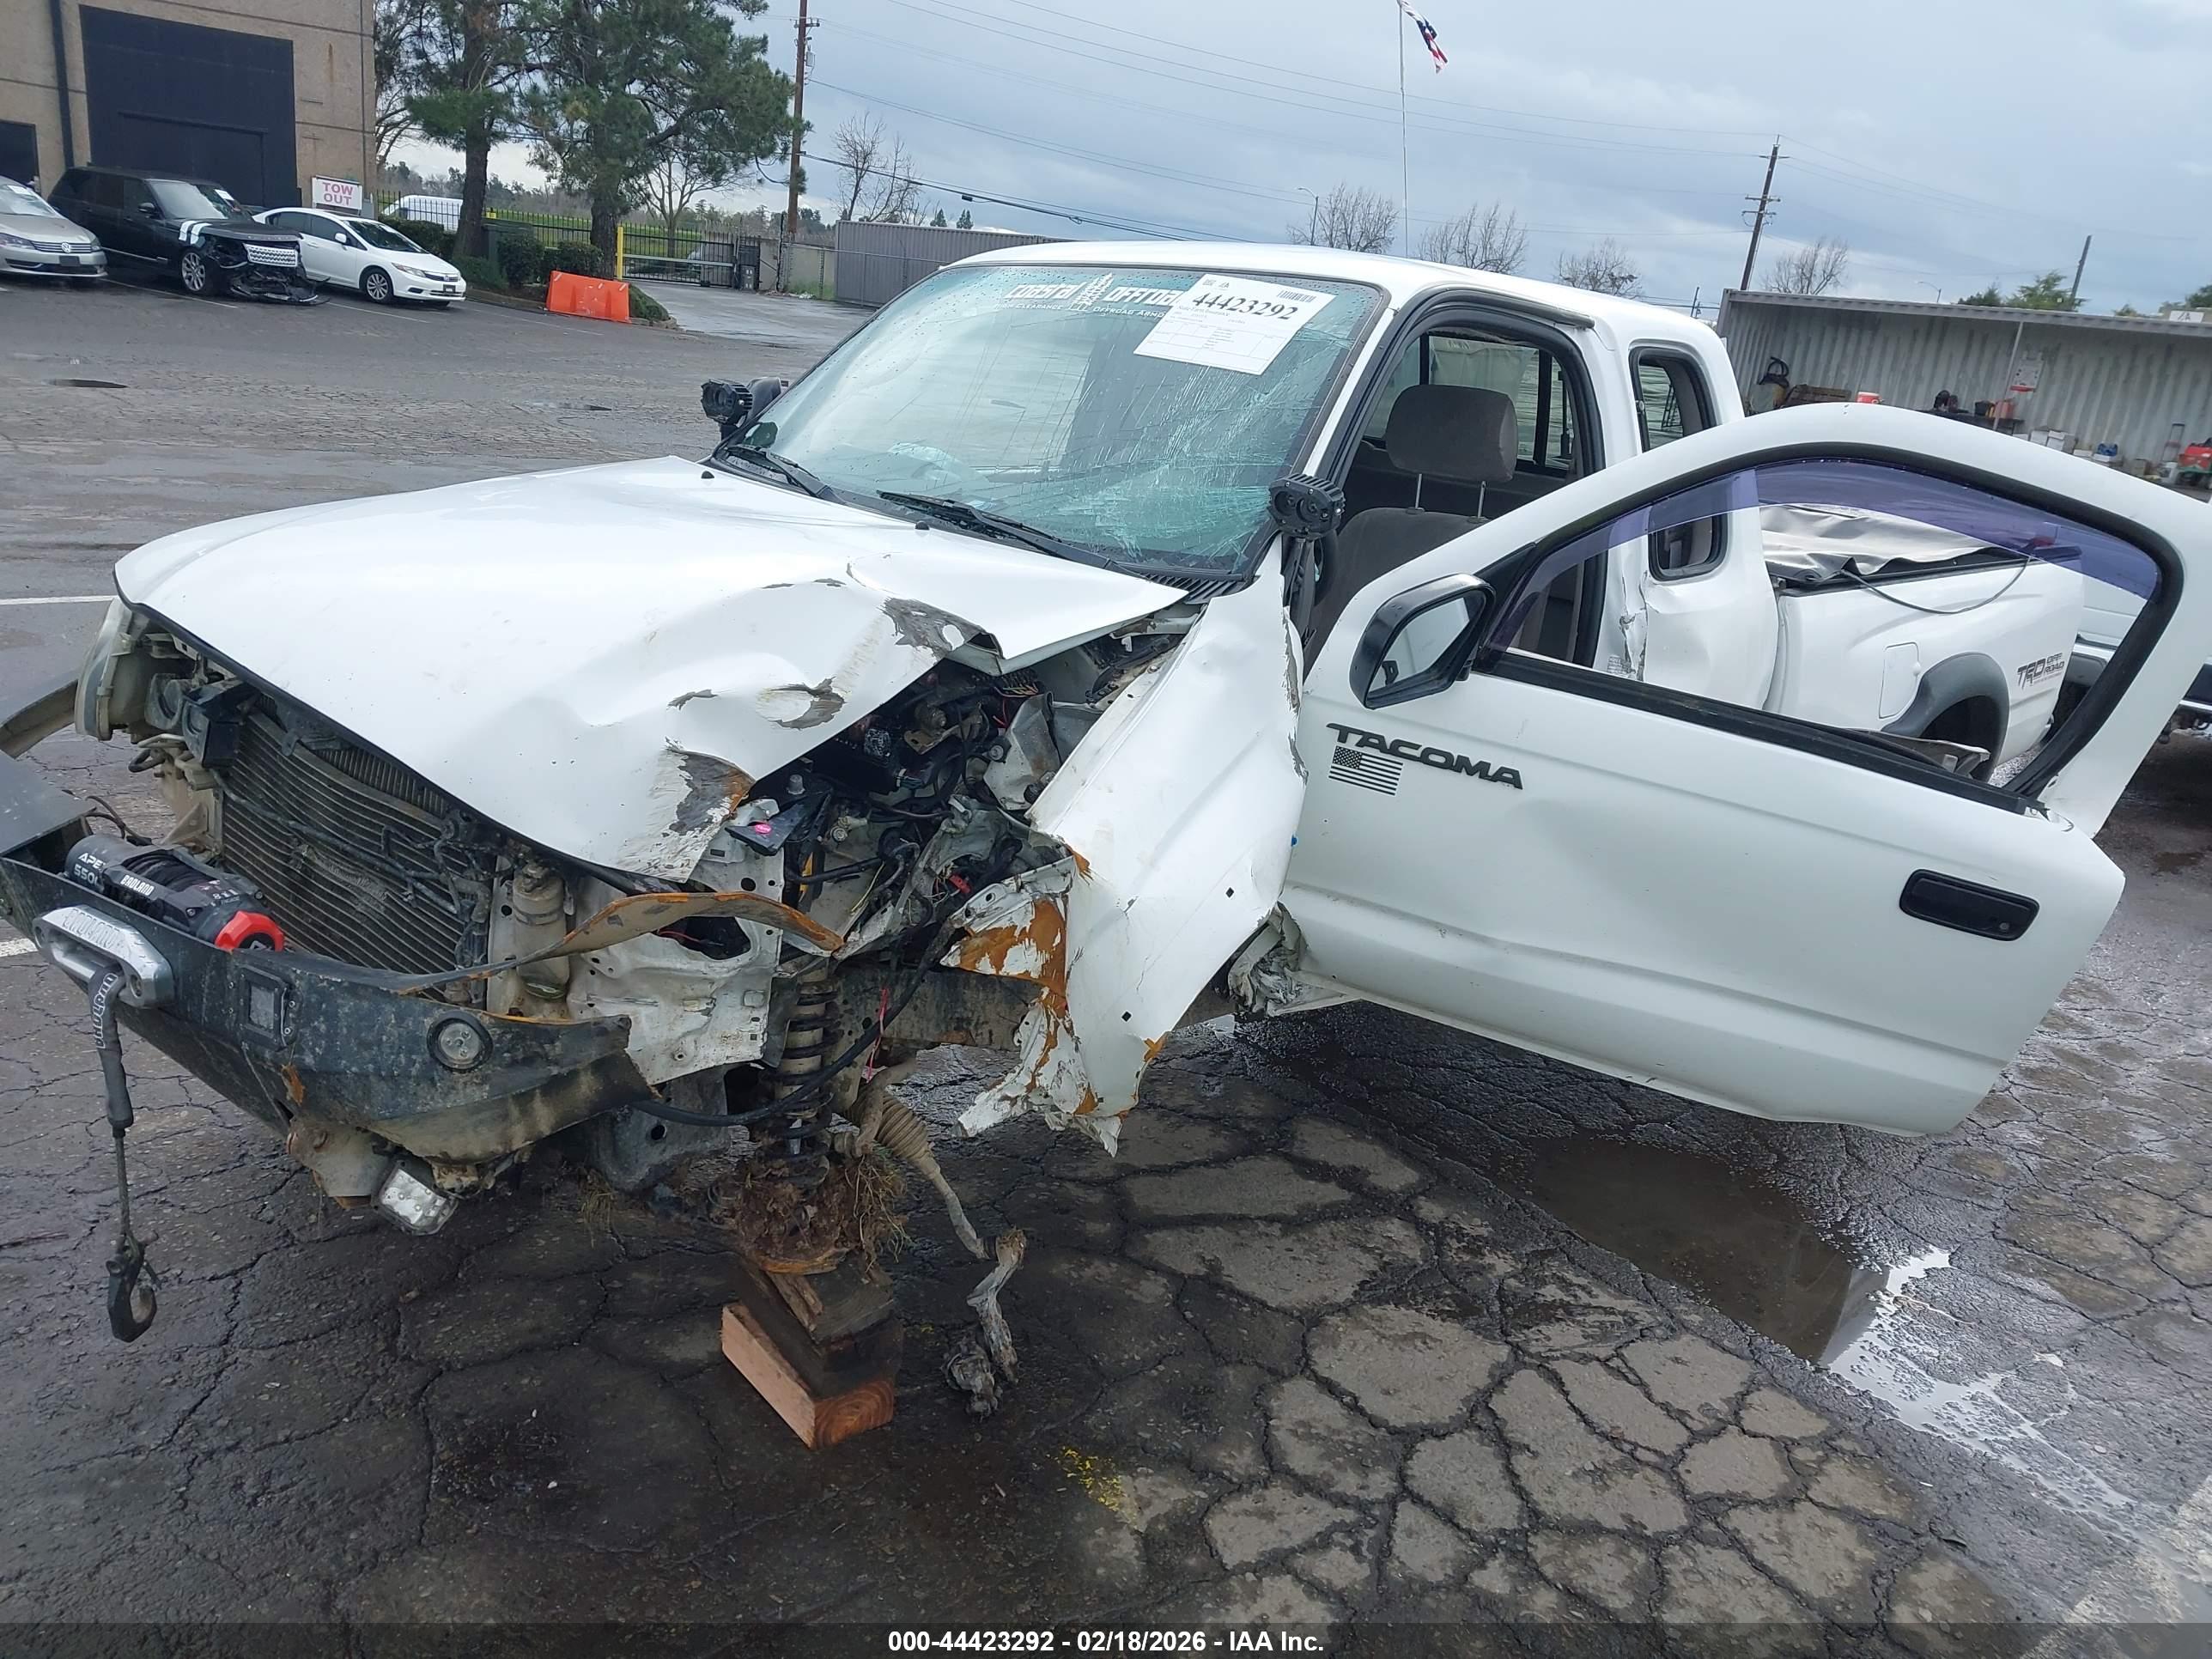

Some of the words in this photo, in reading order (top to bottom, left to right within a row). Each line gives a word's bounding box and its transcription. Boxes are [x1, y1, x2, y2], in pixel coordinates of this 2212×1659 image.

[322, 181, 354, 196] TOW
[323, 192, 353, 206] OUT
[1193, 292, 1298, 320] 44423292
[2017, 658, 2046, 690] TRD
[1326, 722, 1523, 791] TACOMA
[119, 874, 155, 896] BADLAND
[93, 972, 118, 1049] BADLAND
